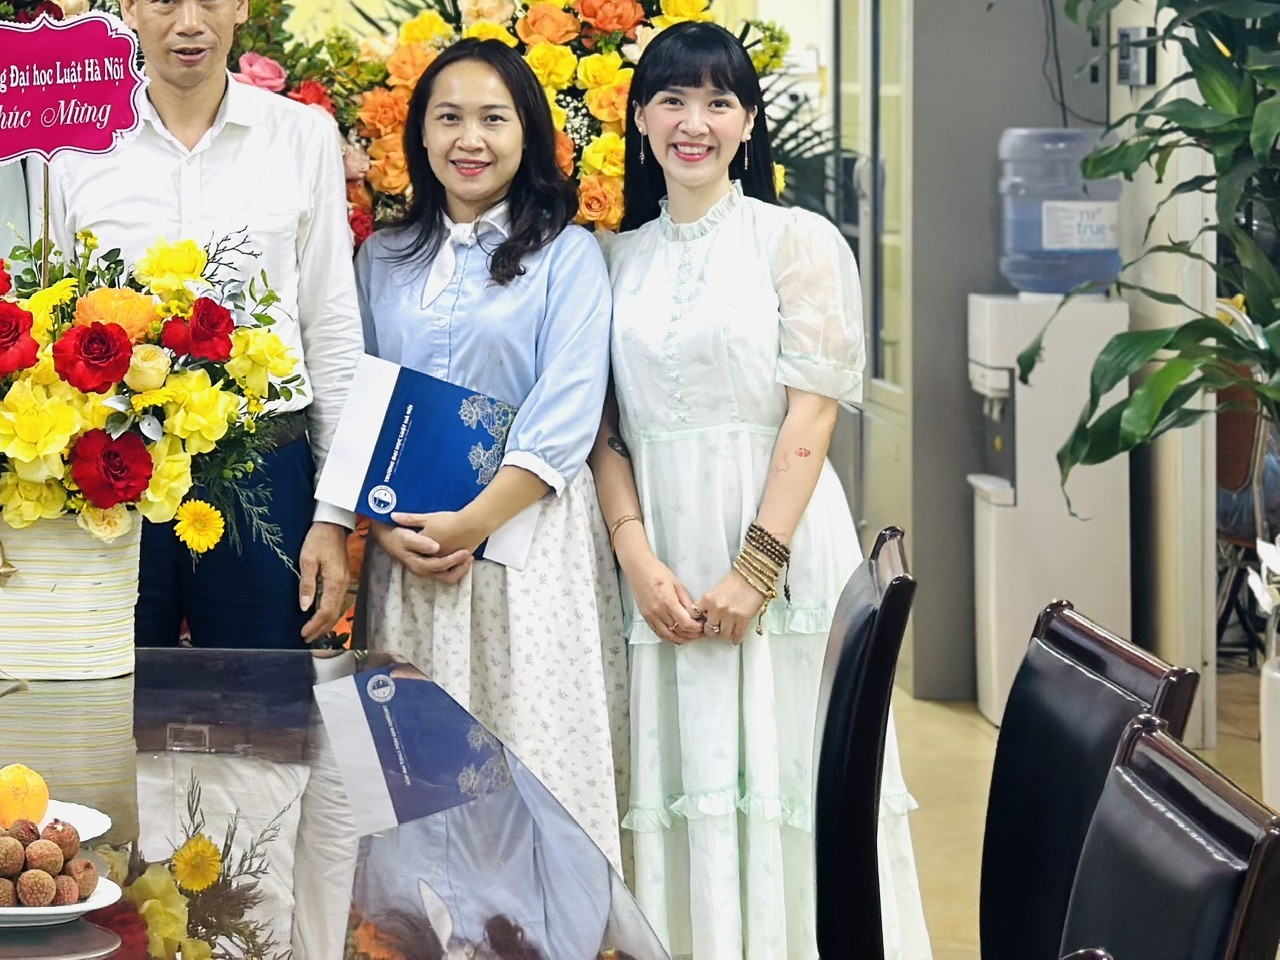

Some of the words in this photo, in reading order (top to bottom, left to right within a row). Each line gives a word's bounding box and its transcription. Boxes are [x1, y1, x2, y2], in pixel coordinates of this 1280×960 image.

[9, 64, 30, 94] Đại
[33, 63, 53, 91] học
[56, 61, 82, 89] Luật
[84, 58, 101, 82] Hà
[103, 57, 125, 86] Nội
[40, 98, 112, 129] Mừng
